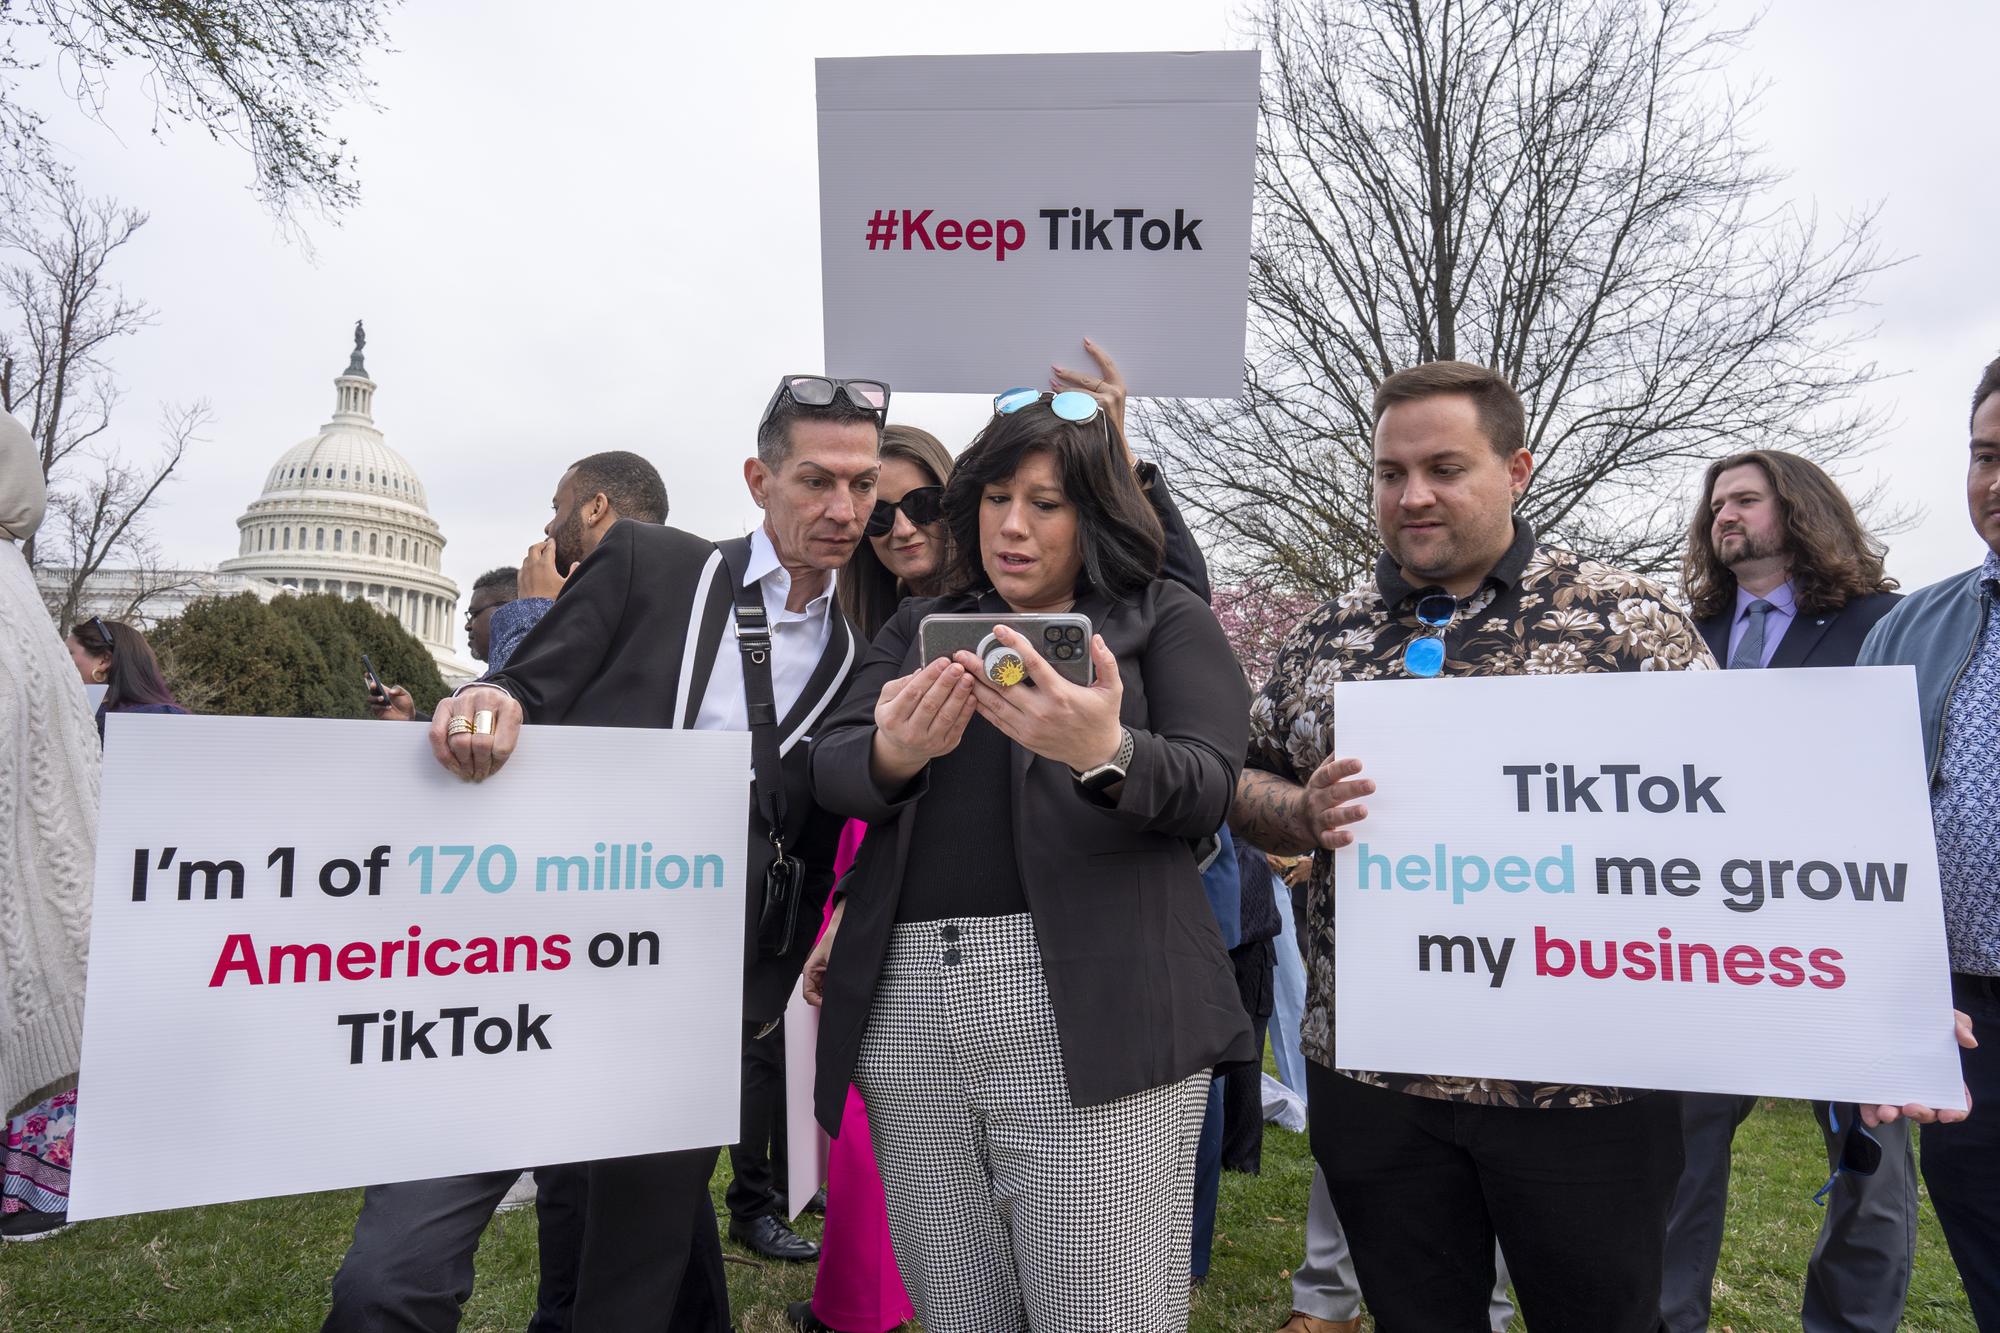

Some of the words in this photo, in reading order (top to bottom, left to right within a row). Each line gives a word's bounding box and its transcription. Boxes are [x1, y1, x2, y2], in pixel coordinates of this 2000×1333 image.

[865, 209, 1026, 262] #Keep
[1040, 207, 1203, 251] TikTok
[1503, 763, 1727, 814] TikTok
[132, 847, 246, 903] I'm
[267, 847, 296, 899] 1
[319, 845, 392, 898] of
[408, 844, 517, 895] 170
[536, 842, 724, 892] million
[1358, 843, 1575, 905] helped
[1596, 857, 1701, 898] me
[1721, 859, 1908, 913] grow
[208, 925, 572, 988] Americans
[588, 931, 660, 969] on
[1419, 935, 1516, 989] my
[1535, 926, 1846, 990] business
[338, 1004, 553, 1065] TikTok
